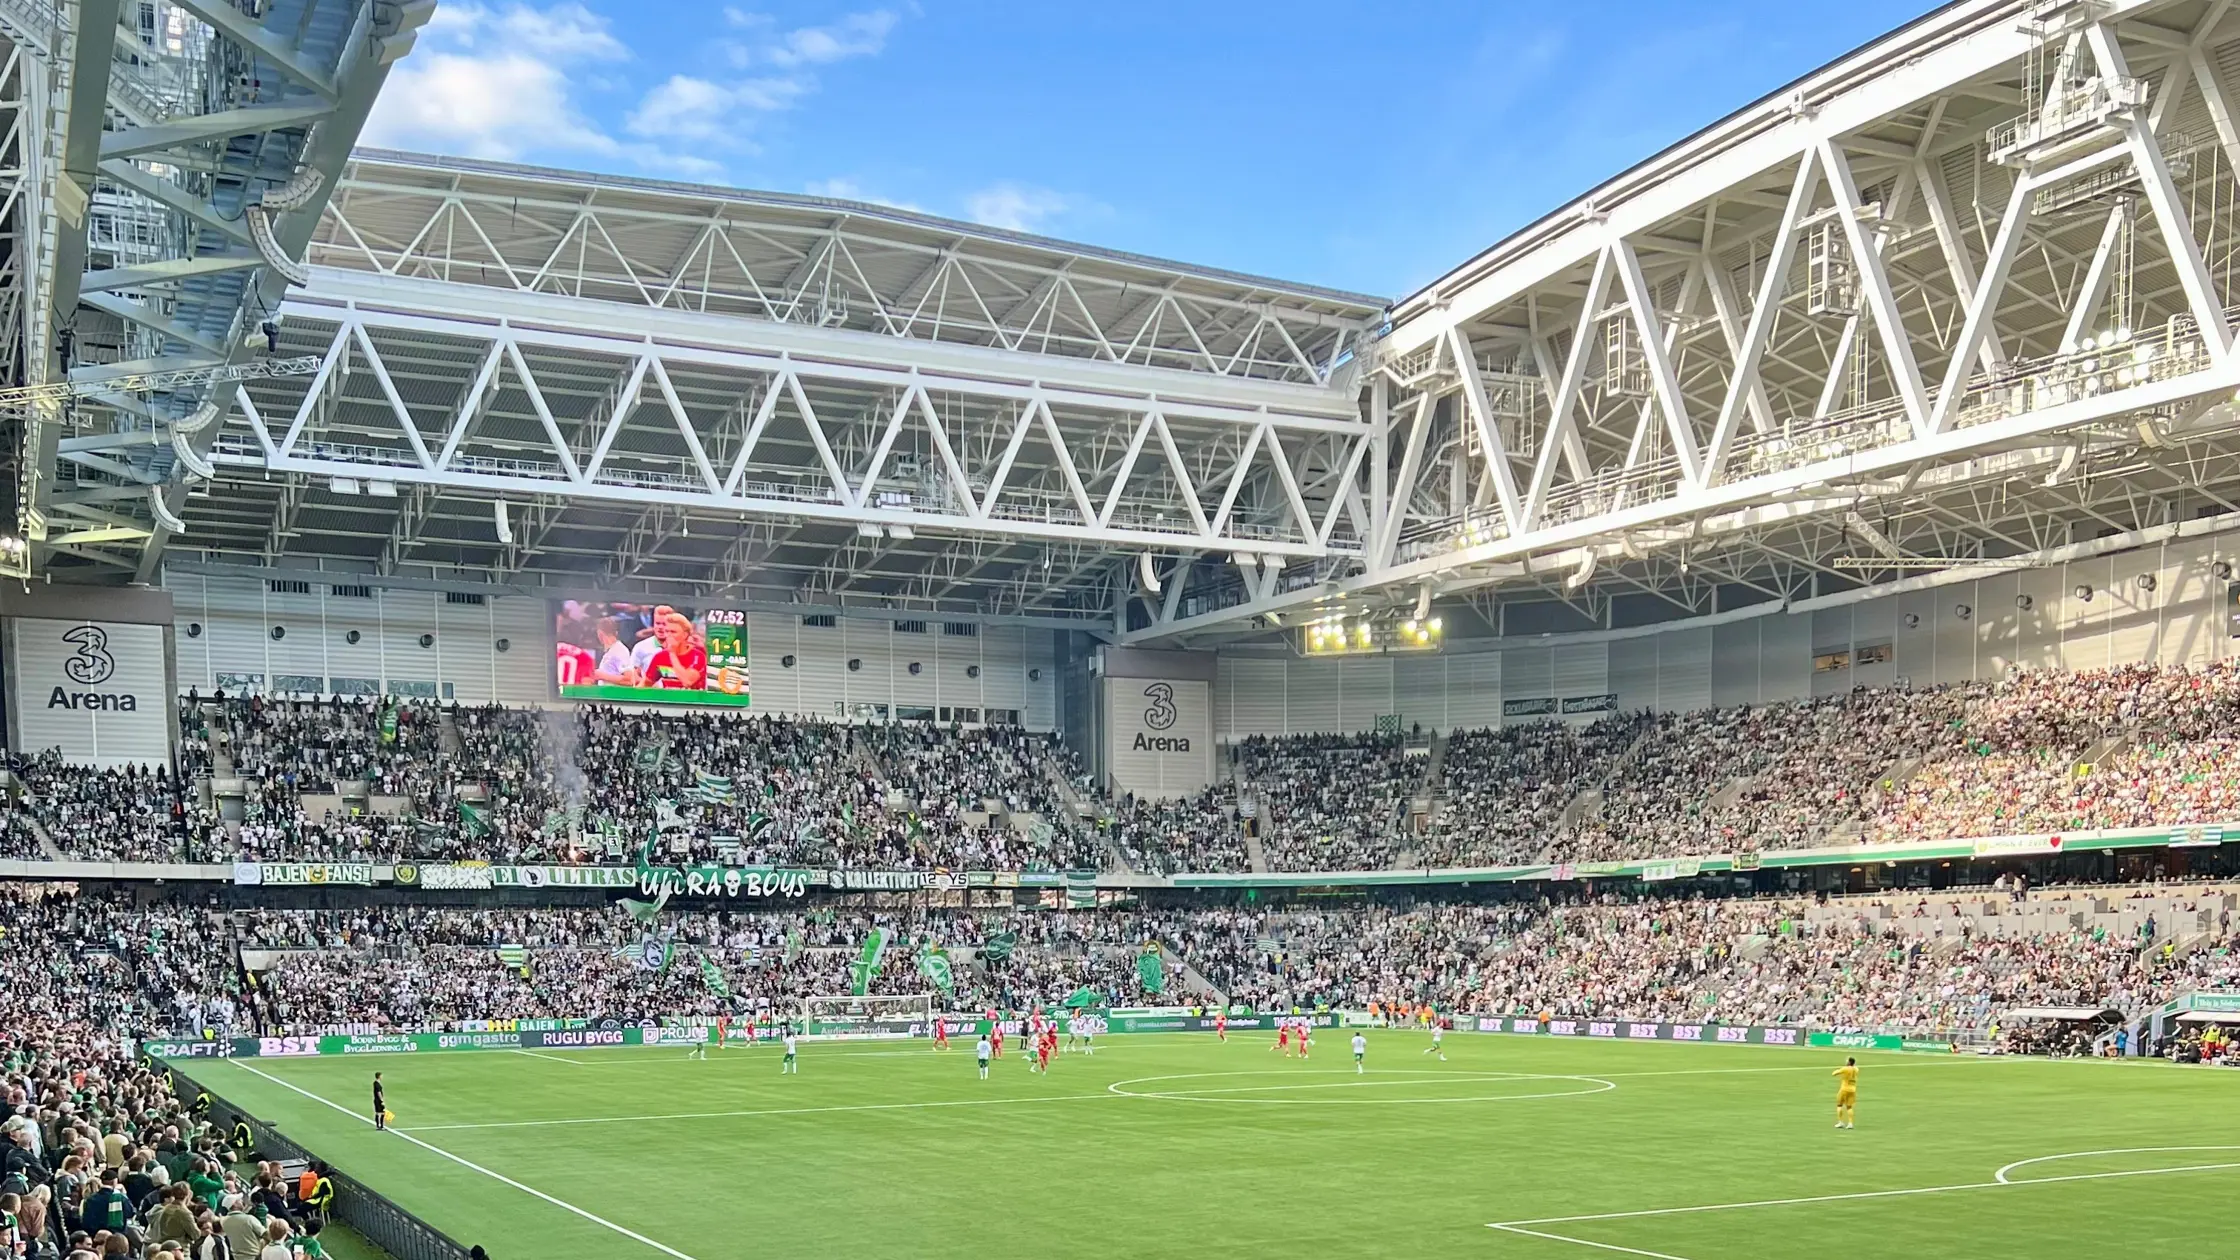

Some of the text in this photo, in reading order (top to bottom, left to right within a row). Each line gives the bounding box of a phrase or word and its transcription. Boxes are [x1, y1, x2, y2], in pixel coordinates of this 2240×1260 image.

[707, 610, 745, 625] 47:52
[48, 686, 136, 711] Arena
[1133, 732, 1190, 752] Arena
[262, 865, 309, 882] BAJEN
[326, 864, 364, 882] FANS
[549, 868, 634, 884] ULTRAS
[845, 871, 920, 888] KOLLEKTIVET
[744, 872, 808, 898] BOYS
[520, 1020, 556, 1032] BAJEN
[909, 1024, 922, 1034] EL
[960, 1023, 977, 1033] AB
[1479, 1018, 1503, 1031] BST
[1514, 1019, 1538, 1032] BST
[1550, 1021, 1576, 1034] BST
[1590, 1022, 1616, 1036] BST
[1630, 1024, 1658, 1038] BST
[543, 1030, 624, 1045] RUGU BYGG
[1673, 1025, 1702, 1040] BST
[1717, 1027, 1748, 1042] BST
[1764, 1029, 1796, 1044] BST
[259, 1037, 321, 1054] BST
[403, 1042, 418, 1051] AB
[1832, 1036, 1868, 1047] CRAFT
[148, 1042, 217, 1057] CRAFT
